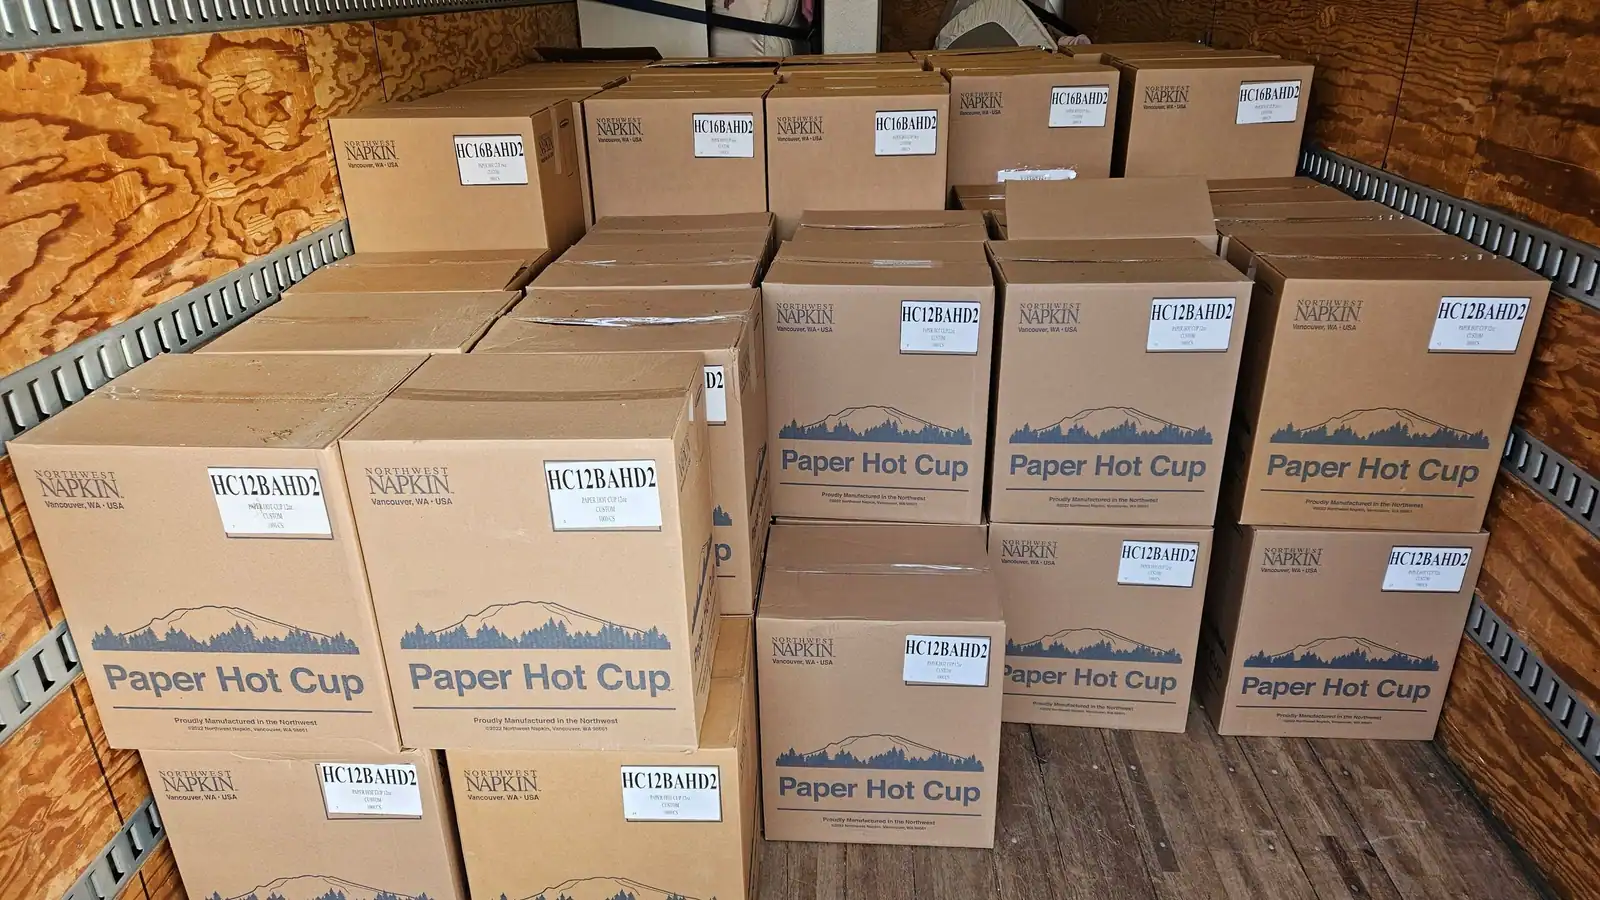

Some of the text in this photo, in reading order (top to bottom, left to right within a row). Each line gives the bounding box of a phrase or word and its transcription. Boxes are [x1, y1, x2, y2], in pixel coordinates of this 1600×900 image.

[1052, 92, 1107, 105] HC16BAHD2
[1144, 90, 1188, 103] NAPKIN
[1240, 86, 1299, 102] HC16BAHD2
[960, 96, 1001, 109] NAPKIN
[597, 123, 641, 136] NAPKIN
[695, 119, 752, 134] HC16BAHD2
[777, 121, 823, 134] NAPKIN
[877, 115, 936, 130] HC16BAHD2
[346, 146, 397, 160] NAPKIN
[456, 141, 524, 158] HC16BAHD2
[776, 309, 833, 325] NAPKIN
[902, 306, 978, 324] HC12BAHD2
[1019, 309, 1079, 324] NAPKIN
[1152, 303, 1232, 320] HC12BAHD2
[1293, 306, 1360, 322] NAPKIN
[1438, 302, 1526, 321] HC12BAHD2
[364, 467, 448, 475] NORTHWEST
[782, 449, 968, 481] Paper Hot Cup
[1010, 454, 1206, 482] Paper Hot Cup
[1267, 454, 1479, 487] Paper Hot Cup
[34, 469, 115, 480] NORTHWEST
[548, 466, 656, 490] HC12BAHD2
[36, 478, 120, 499] NAPKIN
[210, 474, 320, 496] HC12BAHD2
[366, 474, 450, 495] NAPKIN
[44, 500, 87, 510] Vancouver,
[106, 502, 124, 510] USA
[372, 498, 414, 506] Vancouver,
[1001, 545, 1056, 559] NAPKIN
[1122, 544, 1196, 562] HC12BAHD2
[1264, 547, 1323, 555] NORTHWEST
[1390, 551, 1469, 567] HC12BAHD2
[1262, 553, 1321, 566] NAPKIN
[772, 643, 833, 658] NAPKIN
[906, 639, 987, 659] HC12BAHD2
[103, 664, 364, 701] Paper Hot Cup
[409, 663, 671, 697] Paper Hot Cup
[1074, 668, 1117, 688] Hot
[1125, 670, 1177, 695] Cup
[1241, 677, 1431, 703] Paper Hot Cup
[323, 766, 416, 786] HC12BAHD2
[464, 769, 537, 777] NORTHWEST
[623, 772, 717, 789] HC12BAHD2
[162, 776, 234, 793] NAPKIN
[466, 776, 538, 792] NAPKIN
[779, 776, 980, 806] Paper Hot Cup
